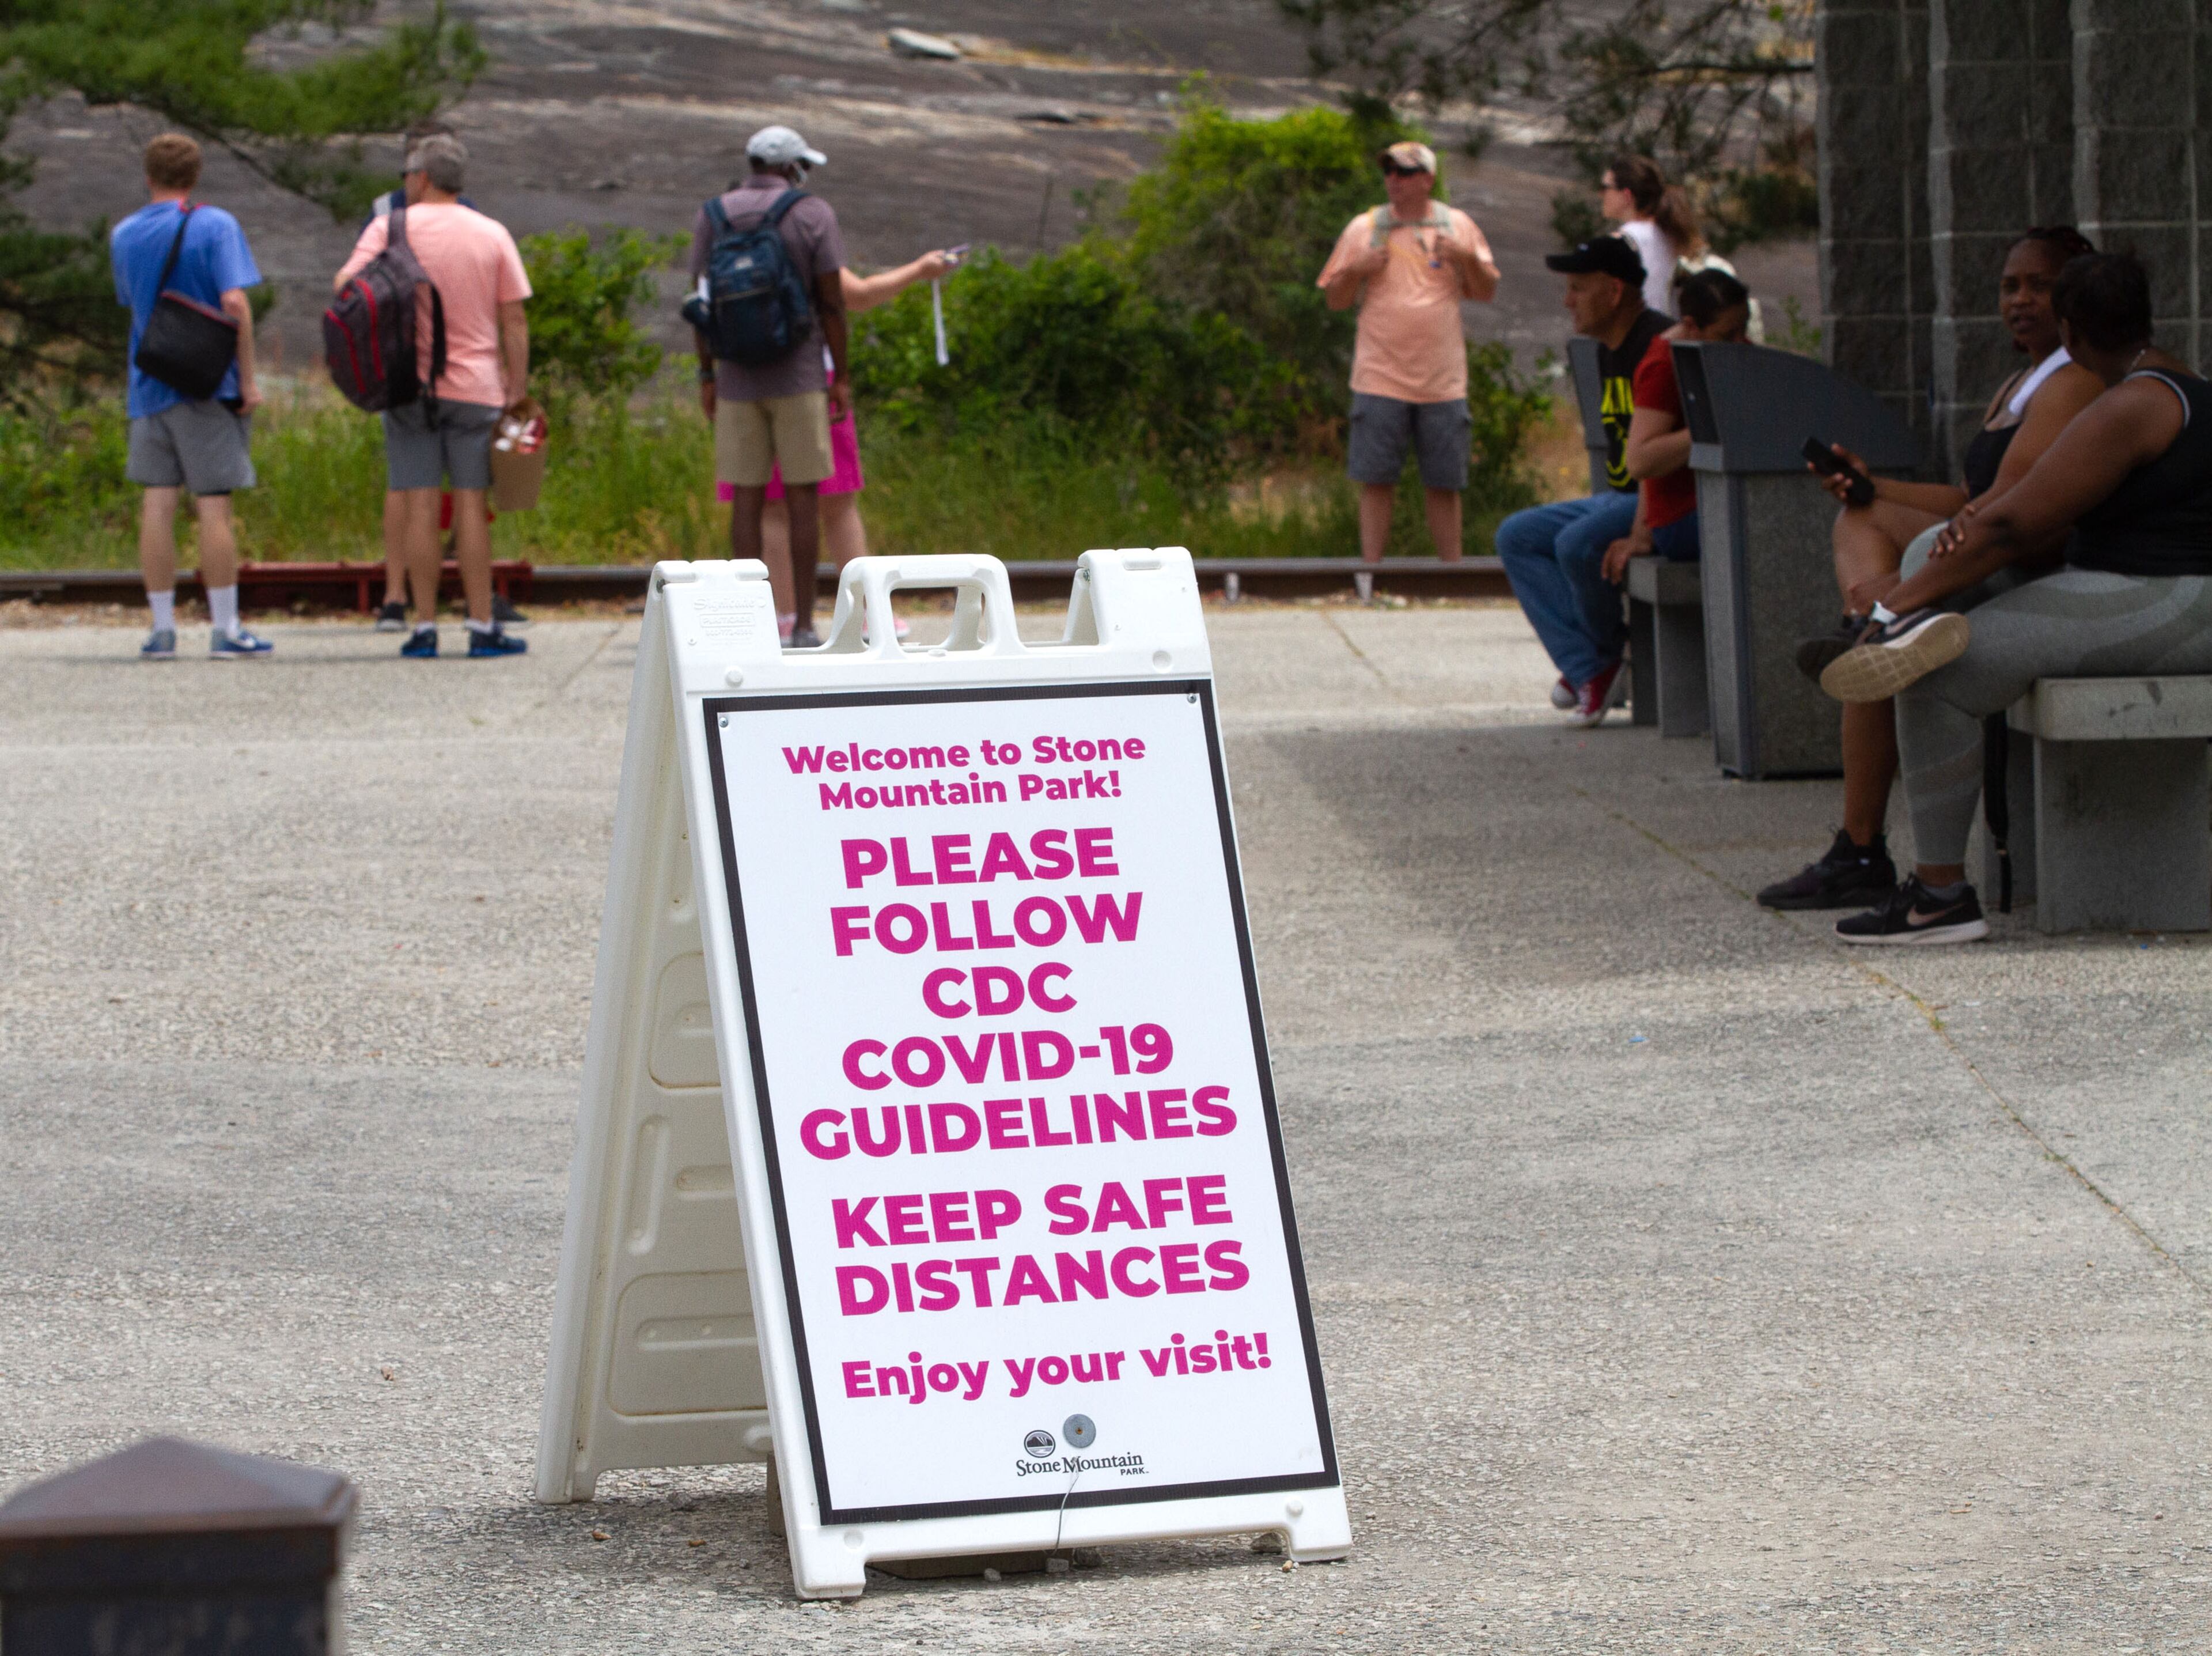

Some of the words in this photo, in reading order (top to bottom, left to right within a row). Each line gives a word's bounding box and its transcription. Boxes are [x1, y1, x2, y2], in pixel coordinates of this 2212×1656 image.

[783, 743, 969, 773] Welcome
[980, 740, 1021, 765] to
[1033, 736, 1145, 764] Stone
[820, 773, 1006, 810] Mountain
[1019, 770, 1121, 801] Park!
[841, 827, 1119, 889] PLEASE
[831, 893, 1142, 956] FOLLOW
[923, 962, 1077, 1018] CDC
[843, 1023, 1173, 1090] COVID-19
[801, 1086, 1237, 1160] GUIDELINES
[832, 1190, 1021, 1248] KEEP
[1044, 1175, 1232, 1235] SAFE
[836, 1240, 1249, 1315] DISTANCES
[842, 1352, 988, 1404] Enjoy
[1005, 1351, 1124, 1397] your
[1140, 1330, 1271, 1377] visit!
[1016, 1458, 1061, 1477] Stone
[1062, 1451, 1144, 1473] Mountain
[1120, 1467, 1145, 1476] PARK
